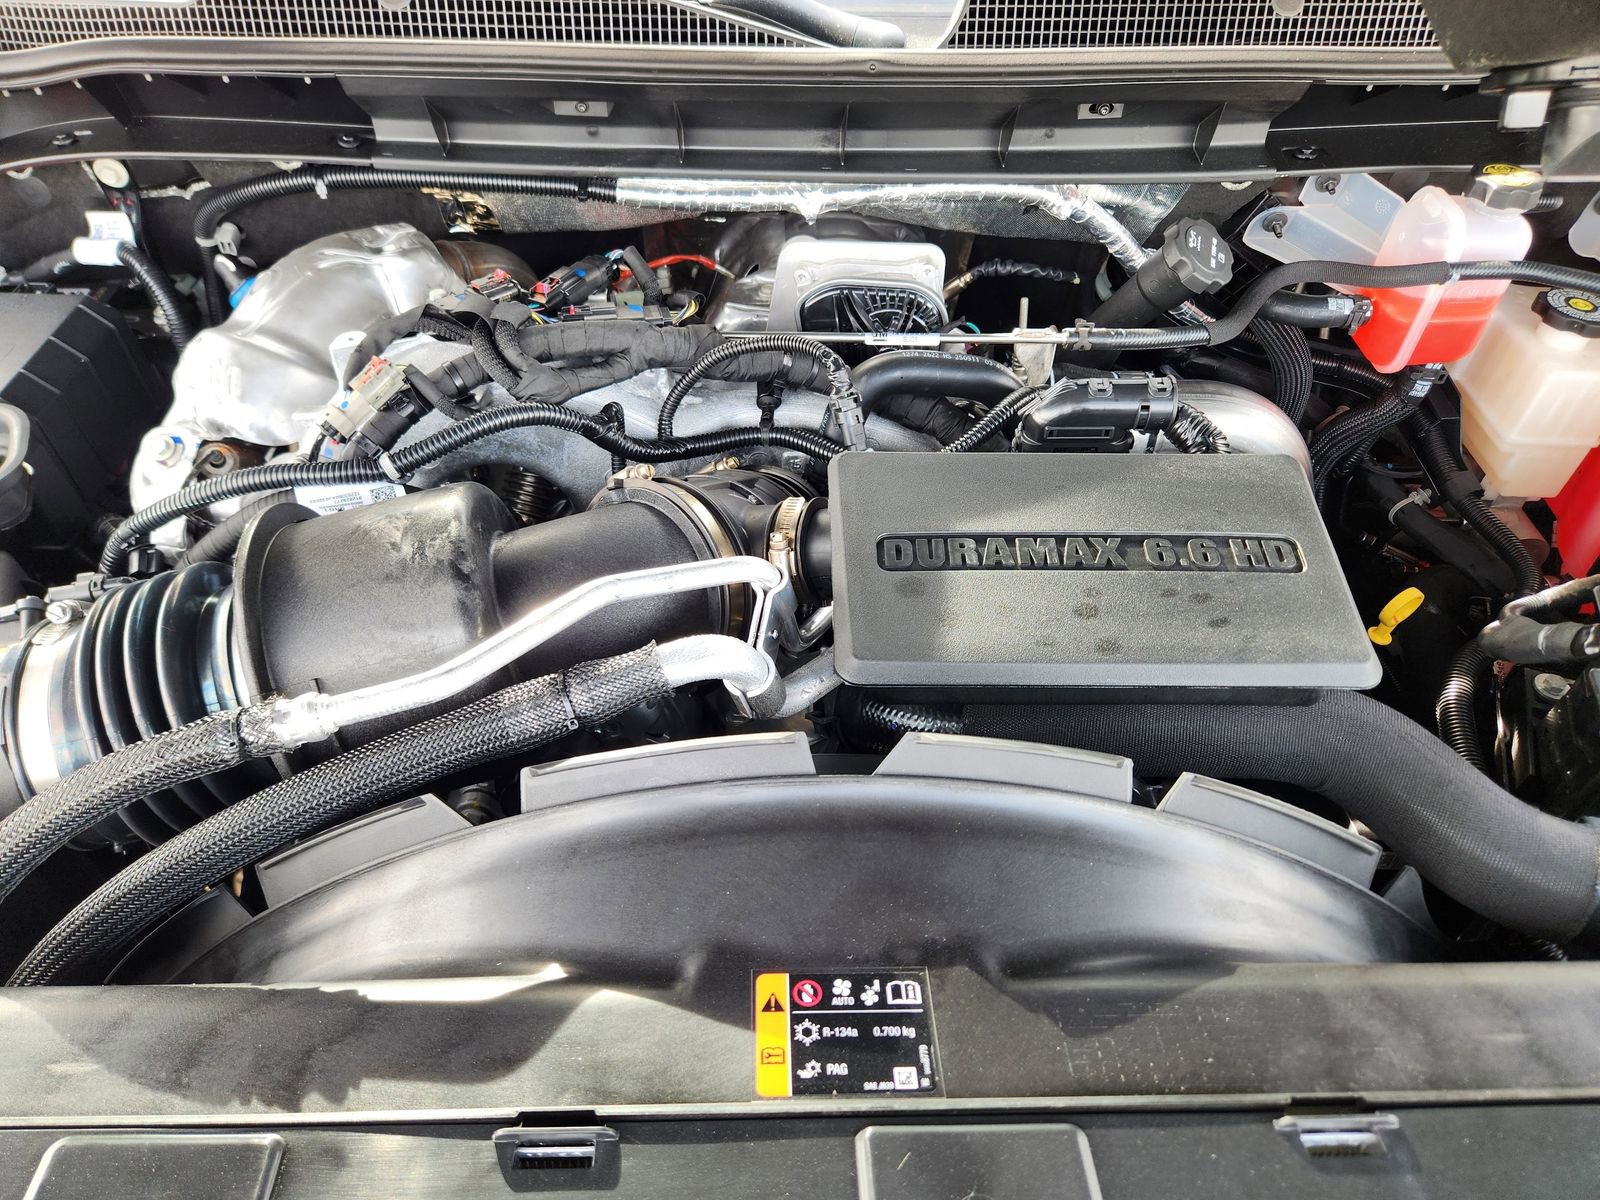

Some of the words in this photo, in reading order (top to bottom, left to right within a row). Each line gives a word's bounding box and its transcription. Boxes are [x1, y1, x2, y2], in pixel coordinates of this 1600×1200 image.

[883, 537, 1128, 570] DURAMAX
[1143, 537, 1221, 567] 6.6
[1229, 538, 1299, 569] HD
[832, 996, 855, 1006] AUTO
[823, 1026, 858, 1037] R-134a
[873, 1026, 901, 1037] 0.700
[902, 1026, 916, 1039] kg
[826, 1063, 849, 1076] PAG
